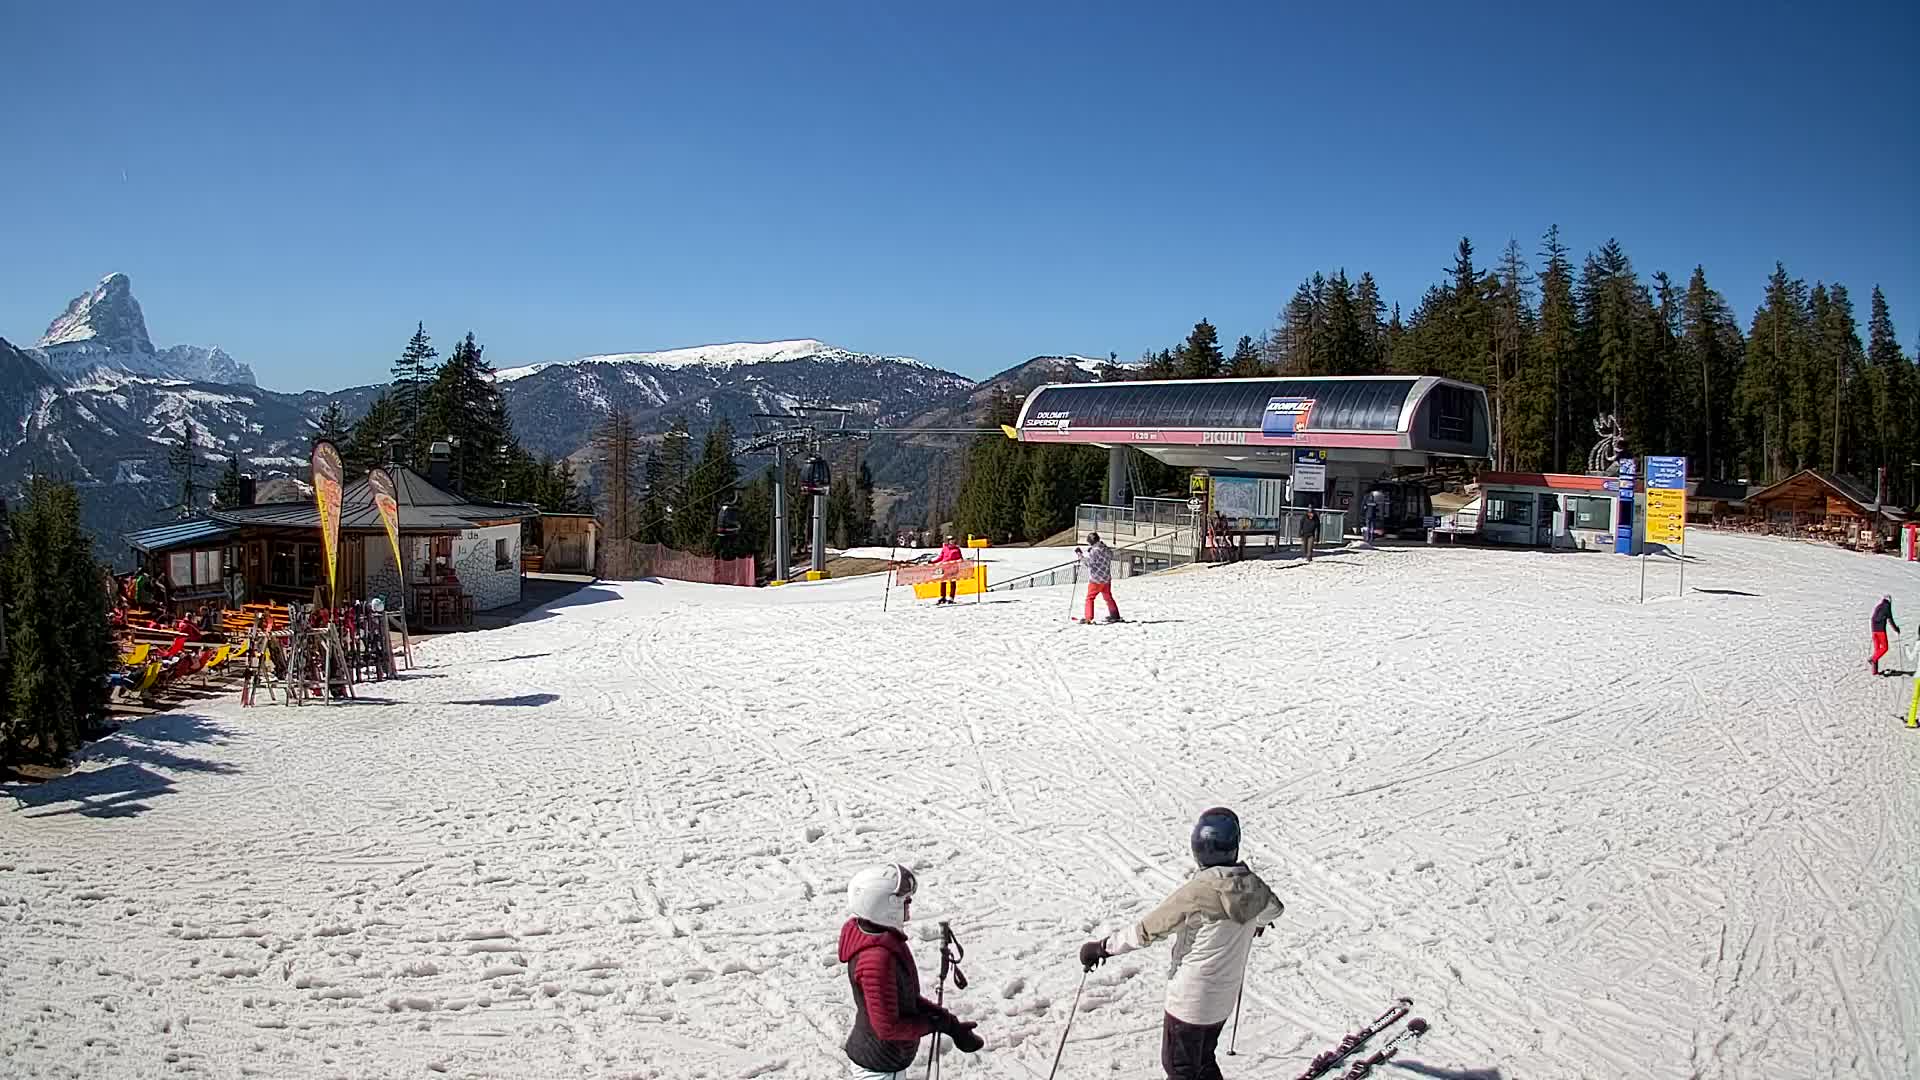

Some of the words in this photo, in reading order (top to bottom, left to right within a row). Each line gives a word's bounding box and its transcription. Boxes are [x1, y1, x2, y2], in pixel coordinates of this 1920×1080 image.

[1037, 411, 1070, 419] DOLOMITI
[1025, 419, 1059, 427] SUPERSKI
[1202, 431, 1246, 444] PICULIN
